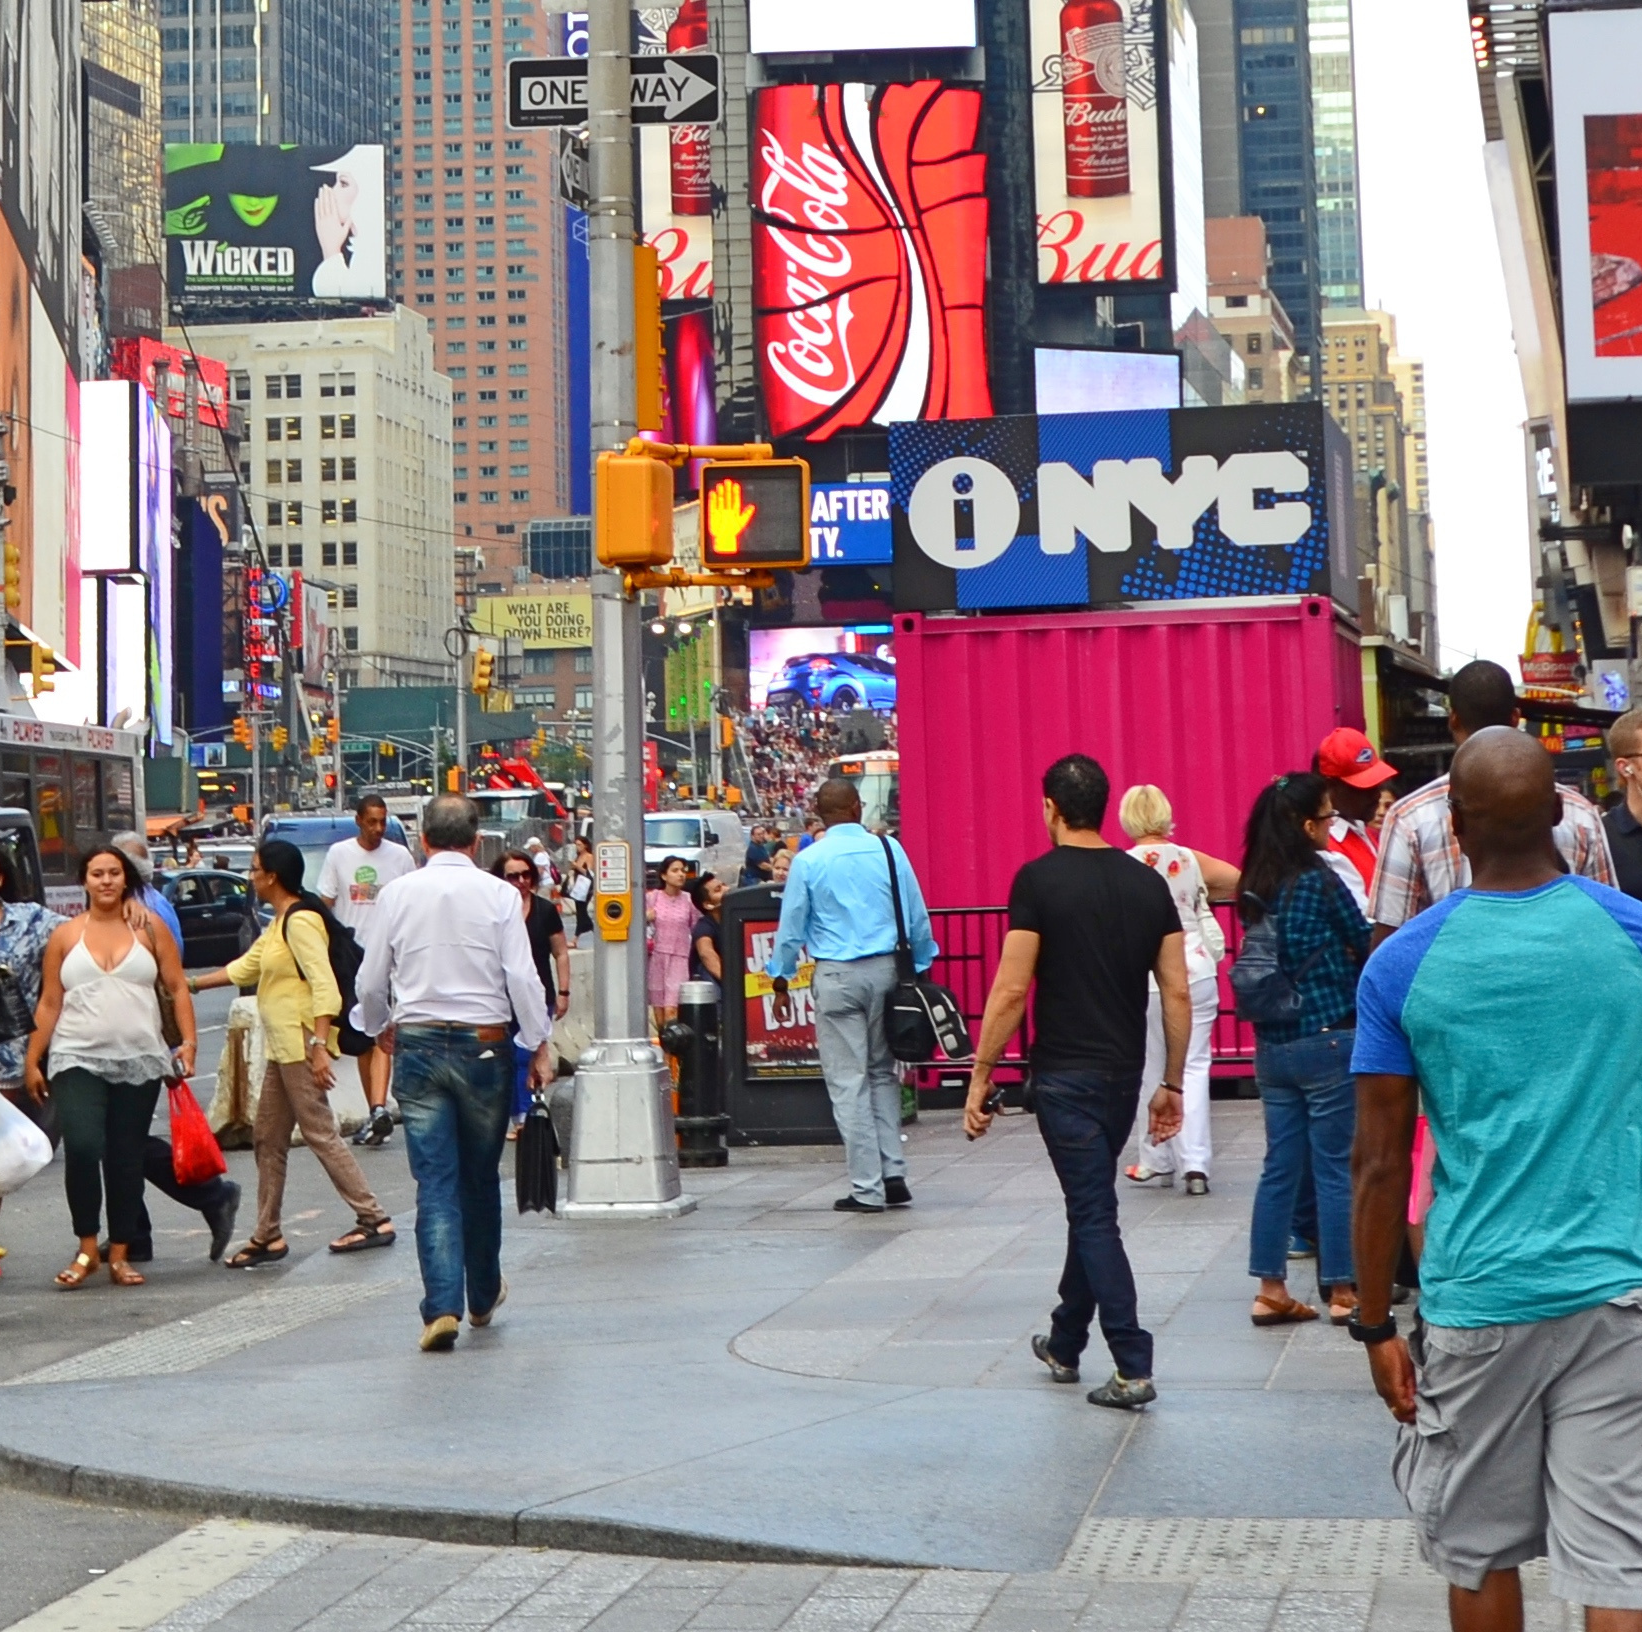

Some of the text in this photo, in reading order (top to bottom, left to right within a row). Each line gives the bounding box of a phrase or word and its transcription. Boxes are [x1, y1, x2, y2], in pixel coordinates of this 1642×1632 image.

[528, 76, 690, 106] ONE WAY
[812, 489, 890, 522] AFTER
[1037, 450, 1312, 555] NYC
[507, 601, 570, 616] WHAT ARE
[517, 614, 585, 628] YOU DOING
[504, 625, 592, 642] DOWN THERE?
[13, 720, 44, 743] PLAYER
[89, 728, 114, 750] PLAYER
